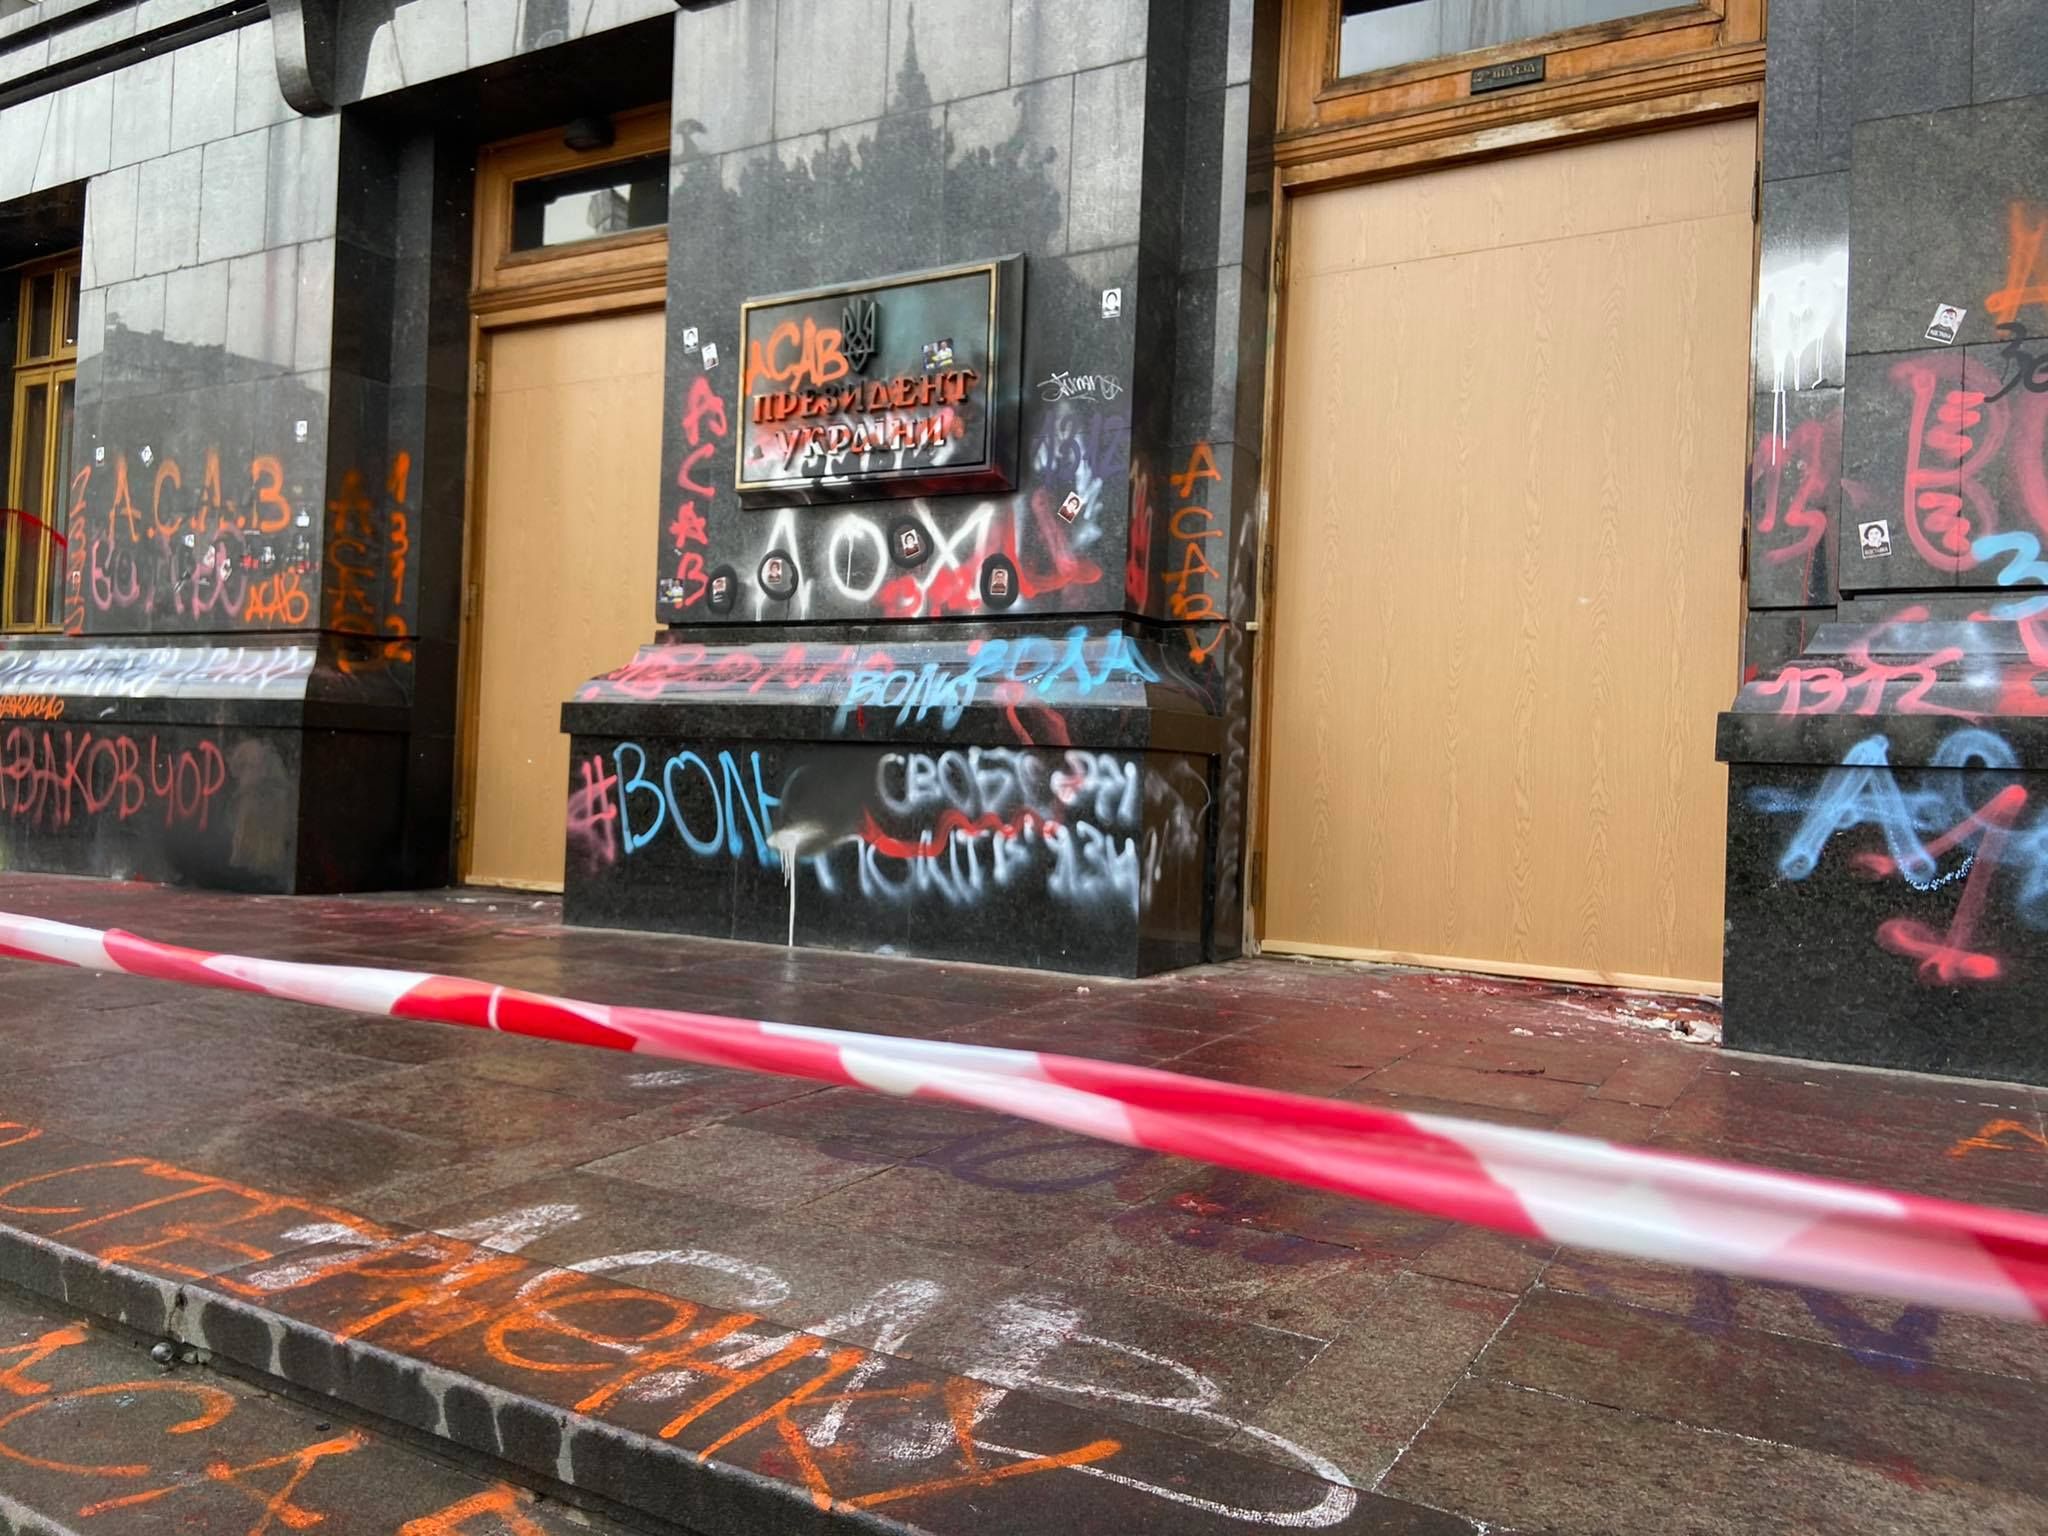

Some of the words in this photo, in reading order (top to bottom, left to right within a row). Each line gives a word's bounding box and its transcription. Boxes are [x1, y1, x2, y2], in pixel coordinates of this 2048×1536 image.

[745, 314, 850, 396] ACAB
[752, 368, 979, 424] ПРЕЗИДЕНТ
[775, 413, 946, 471] УКРАЇНИ
